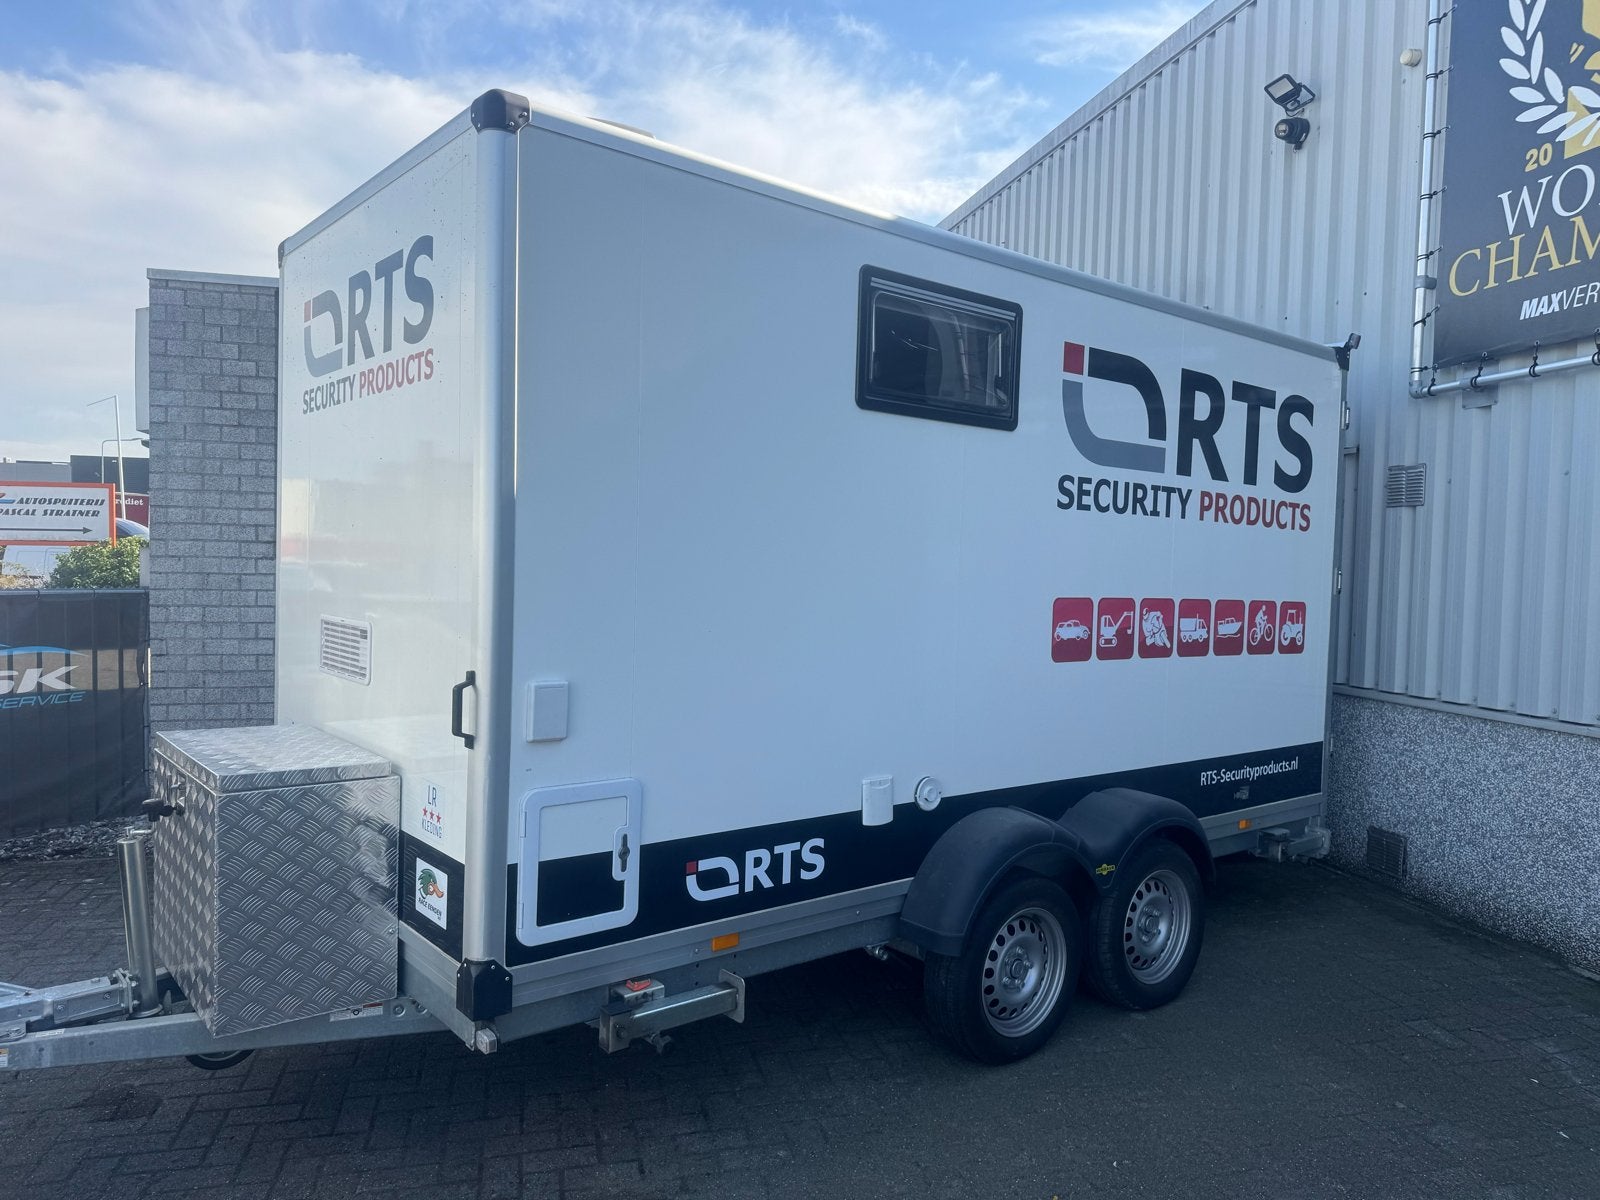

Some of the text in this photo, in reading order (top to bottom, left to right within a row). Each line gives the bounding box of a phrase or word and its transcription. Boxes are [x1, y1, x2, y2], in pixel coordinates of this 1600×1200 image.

[1525, 142, 1553, 173] 20
[1497, 164, 1600, 235] WO
[347, 234, 434, 367] RTS
[302, 347, 434, 415] SECURITY PRODUCTS
[1176, 367, 1314, 494] RTS
[1056, 474, 1311, 532] SECURITY PRODUCTS
[1200, 756, 1299, 786] RTS-Securityproducts.nl
[744, 837, 825, 893] RTS
